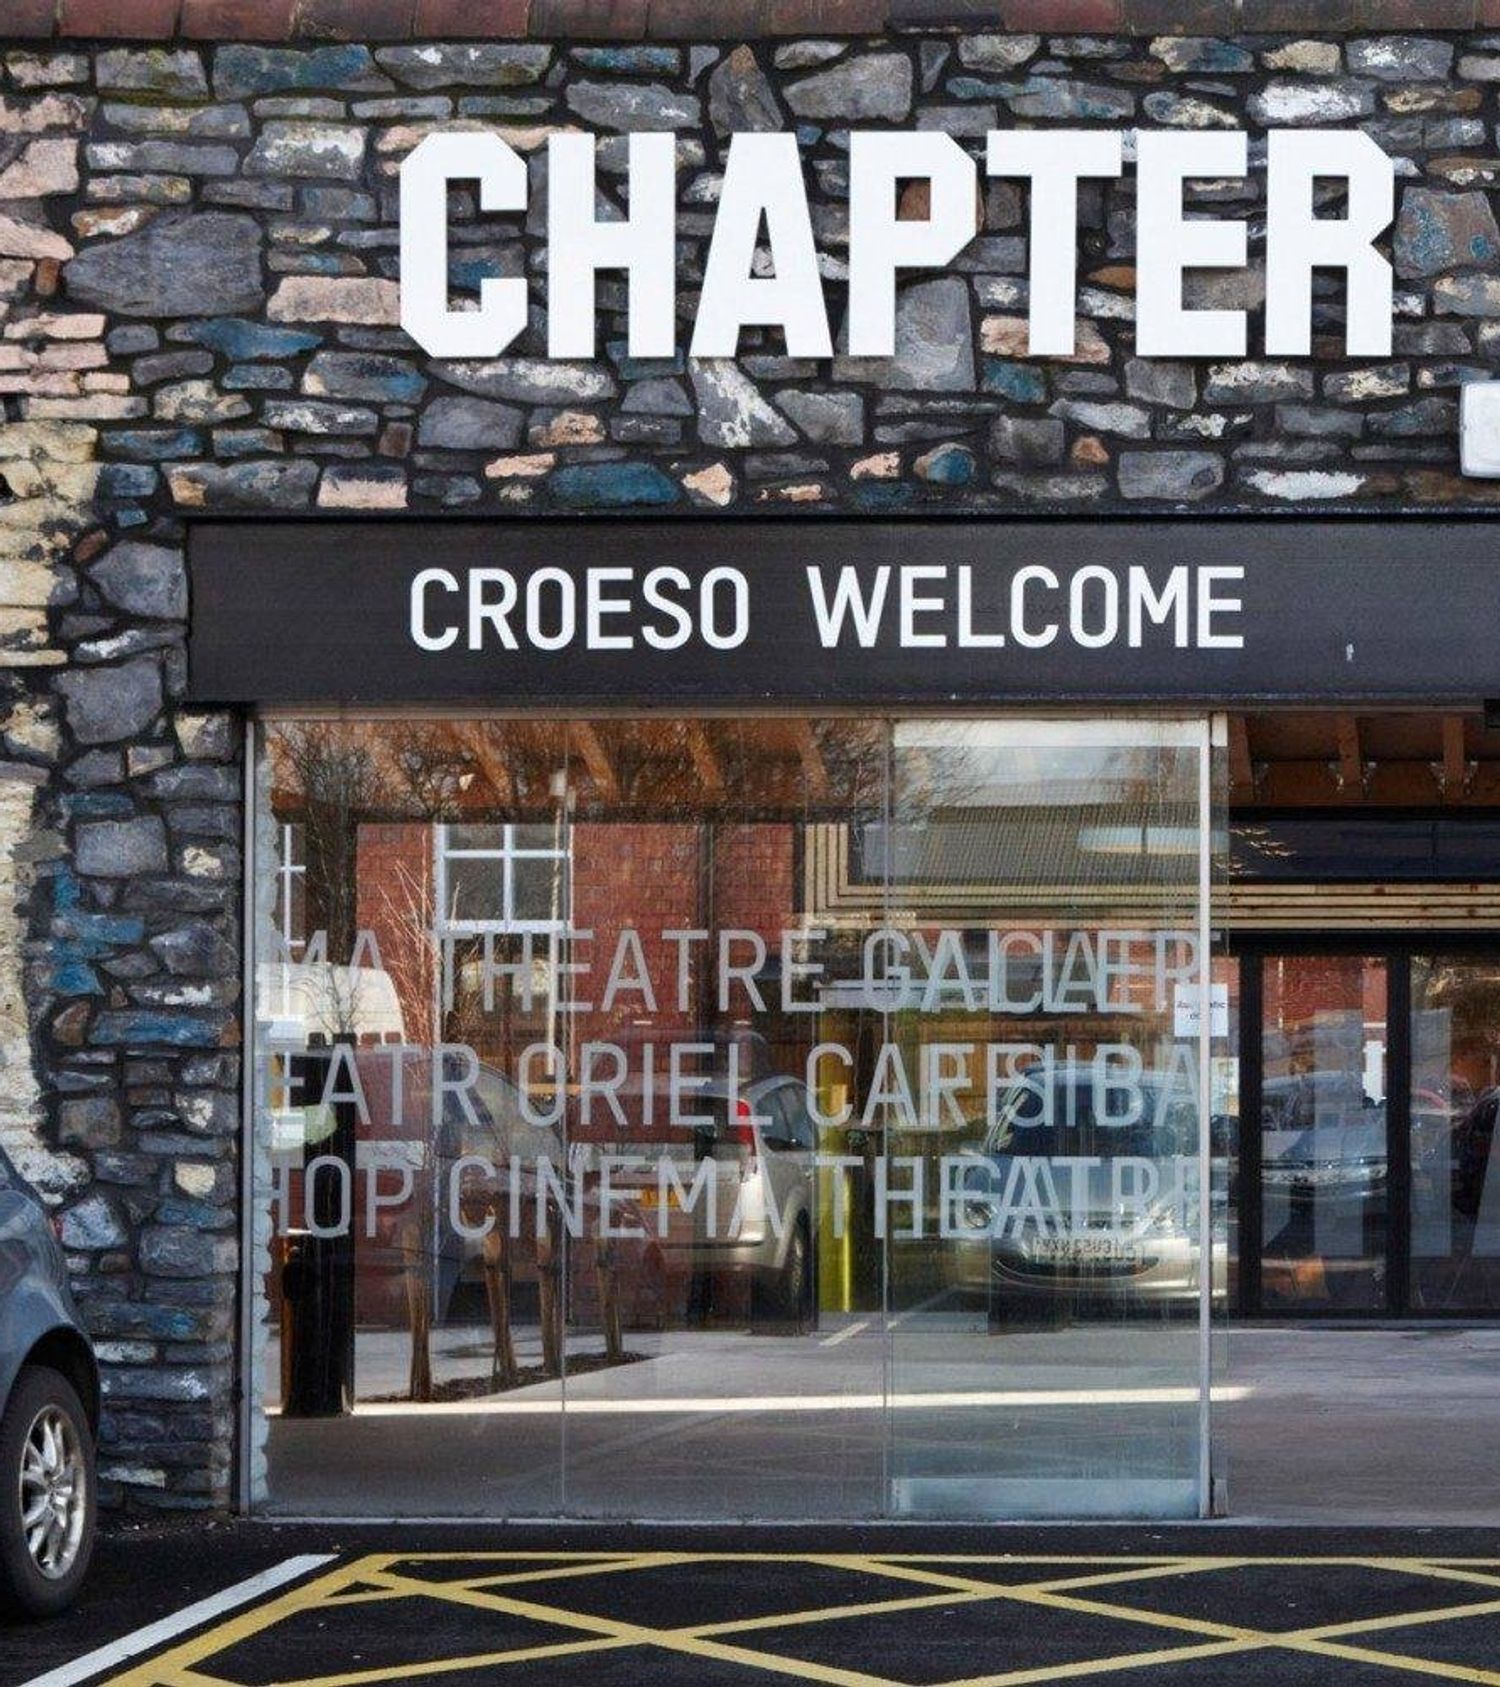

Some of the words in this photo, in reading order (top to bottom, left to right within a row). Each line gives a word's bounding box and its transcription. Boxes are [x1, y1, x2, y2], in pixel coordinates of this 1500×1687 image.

[400, 130, 1394, 358] CHAPTER
[411, 567, 749, 651] CROESO
[806, 565, 1245, 648] WELCOME
[428, 929, 827, 1013] THEATRE
[518, 1043, 773, 1127] ORIEL
[449, 1155, 781, 1239] CINEMA
